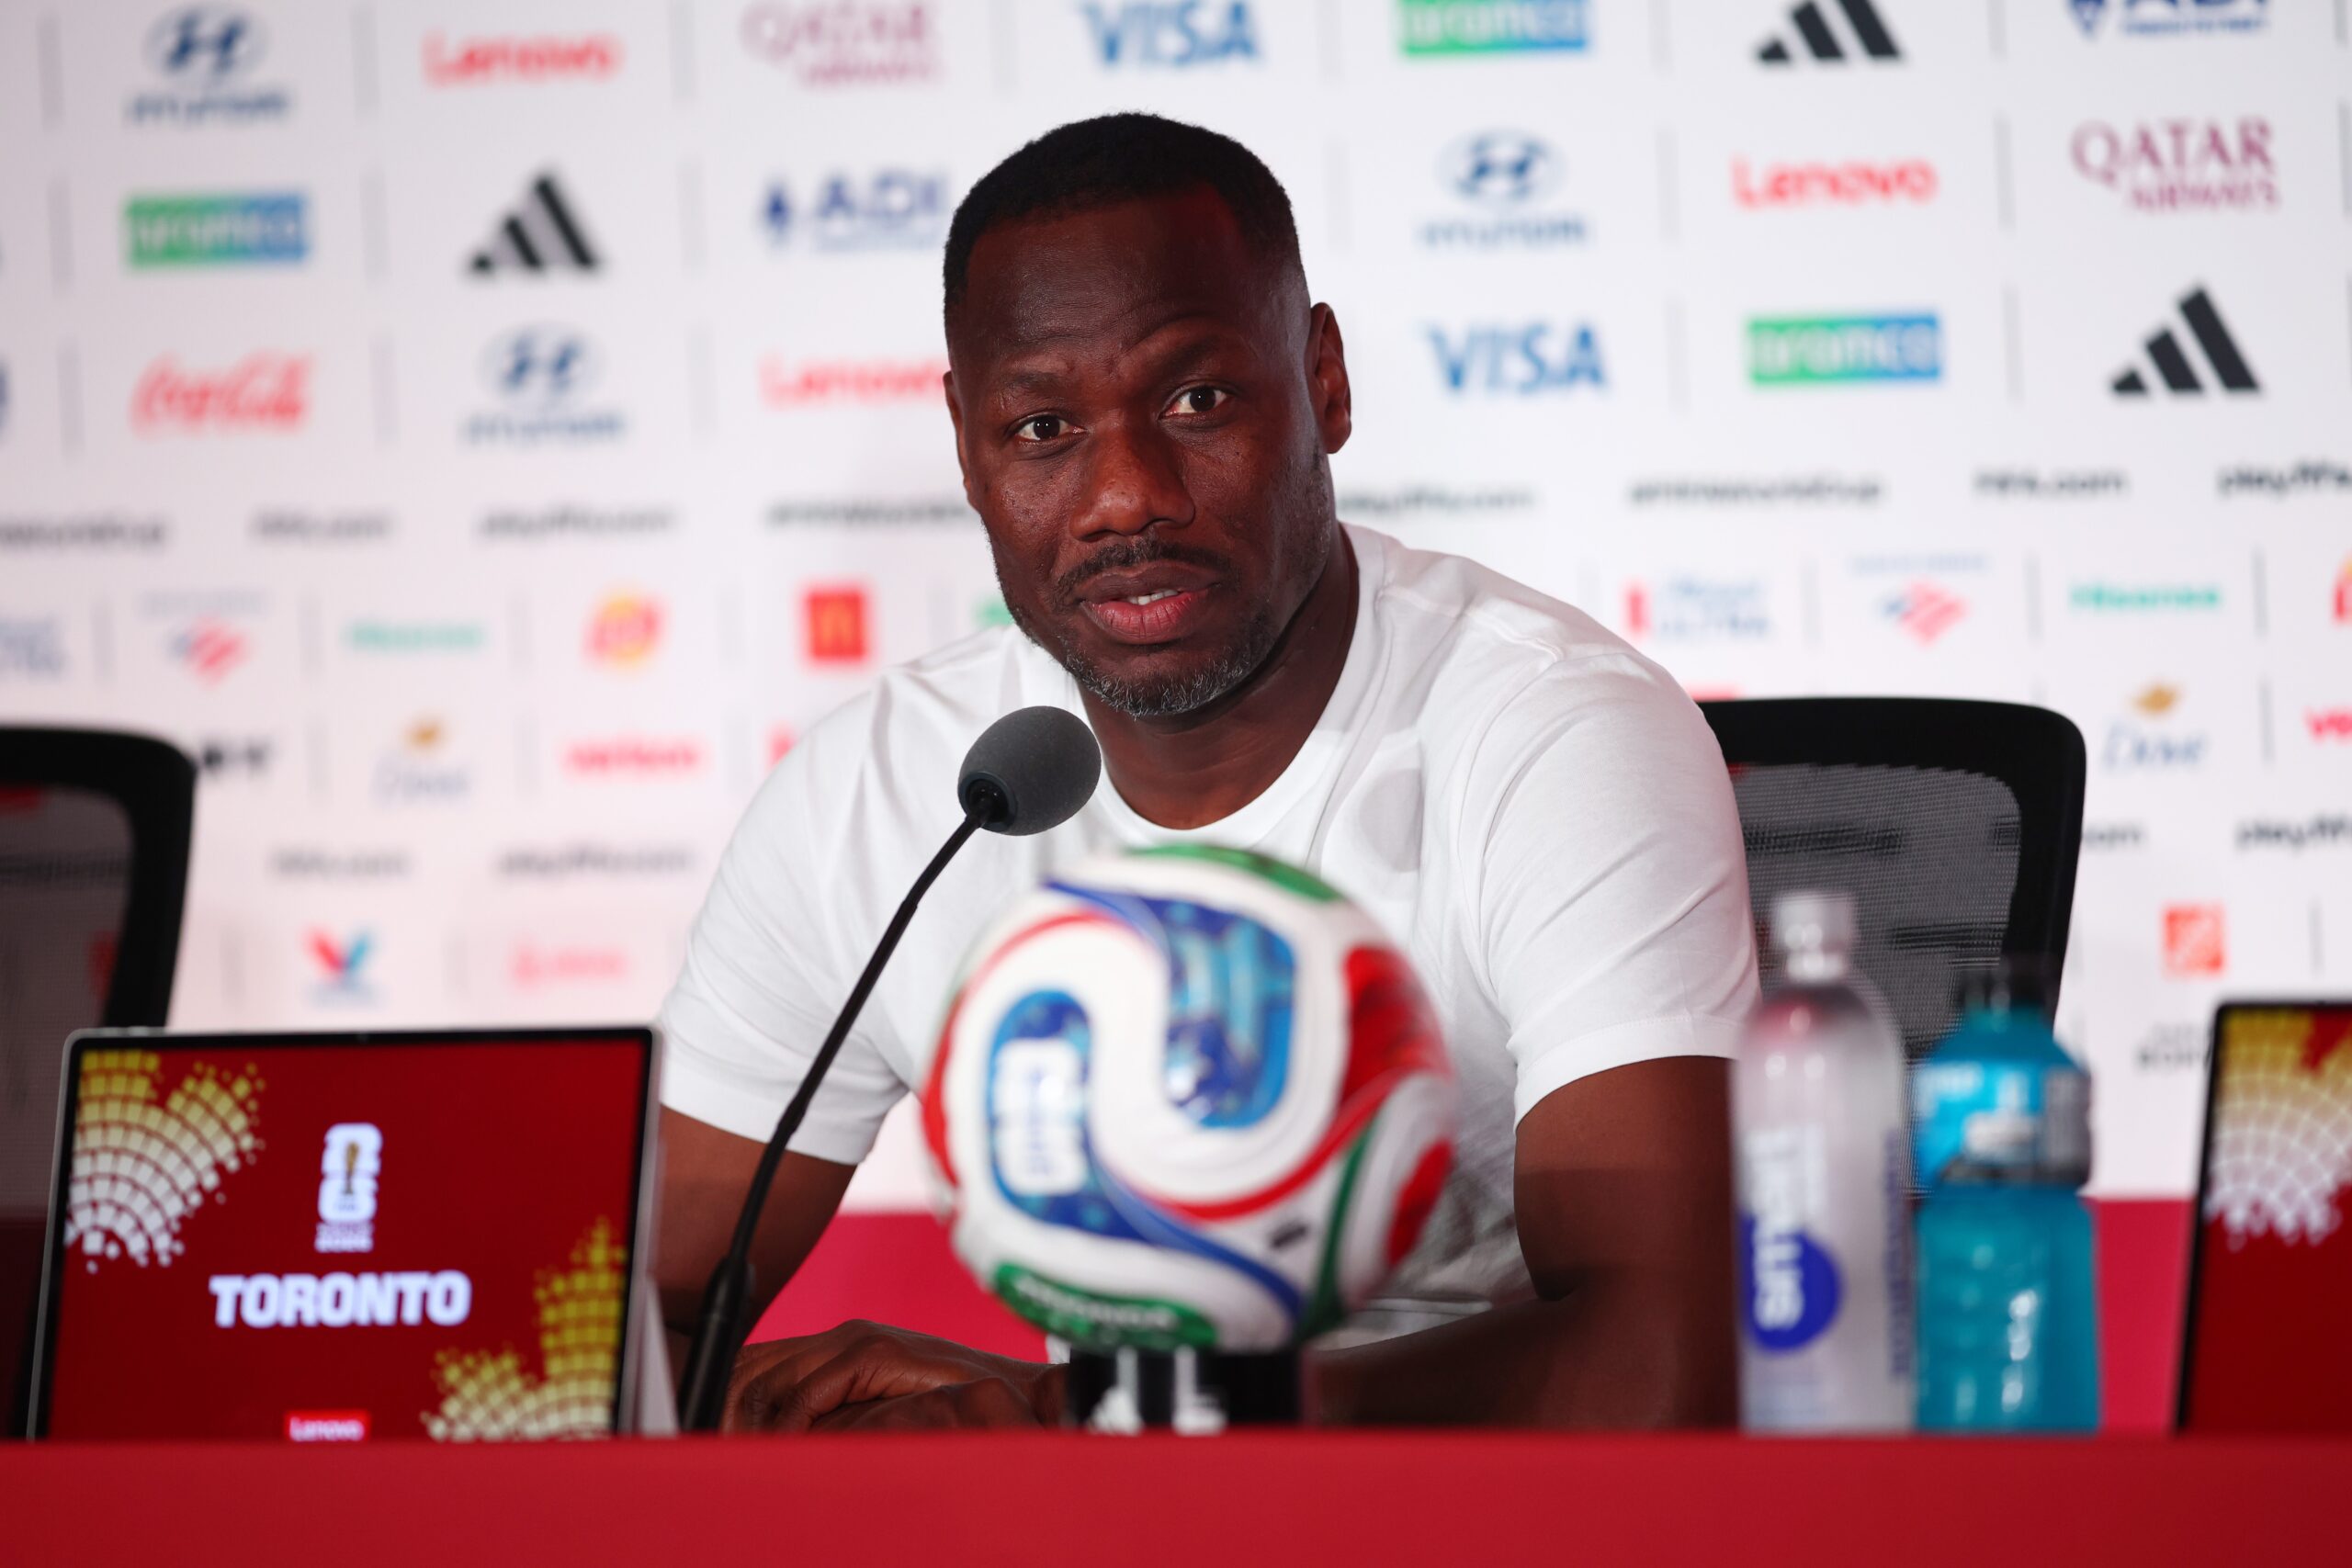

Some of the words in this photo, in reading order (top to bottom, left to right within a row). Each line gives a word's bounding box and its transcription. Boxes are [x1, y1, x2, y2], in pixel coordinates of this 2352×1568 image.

[424, 37, 618, 85] Lenovo
[1082, 0, 1260, 66] VISA
[2072, 118, 2276, 186] QATAR
[1734, 159, 1938, 209] Lenovo
[1429, 321, 1608, 395] VISA
[210, 1271, 471, 1328] TORONTO
